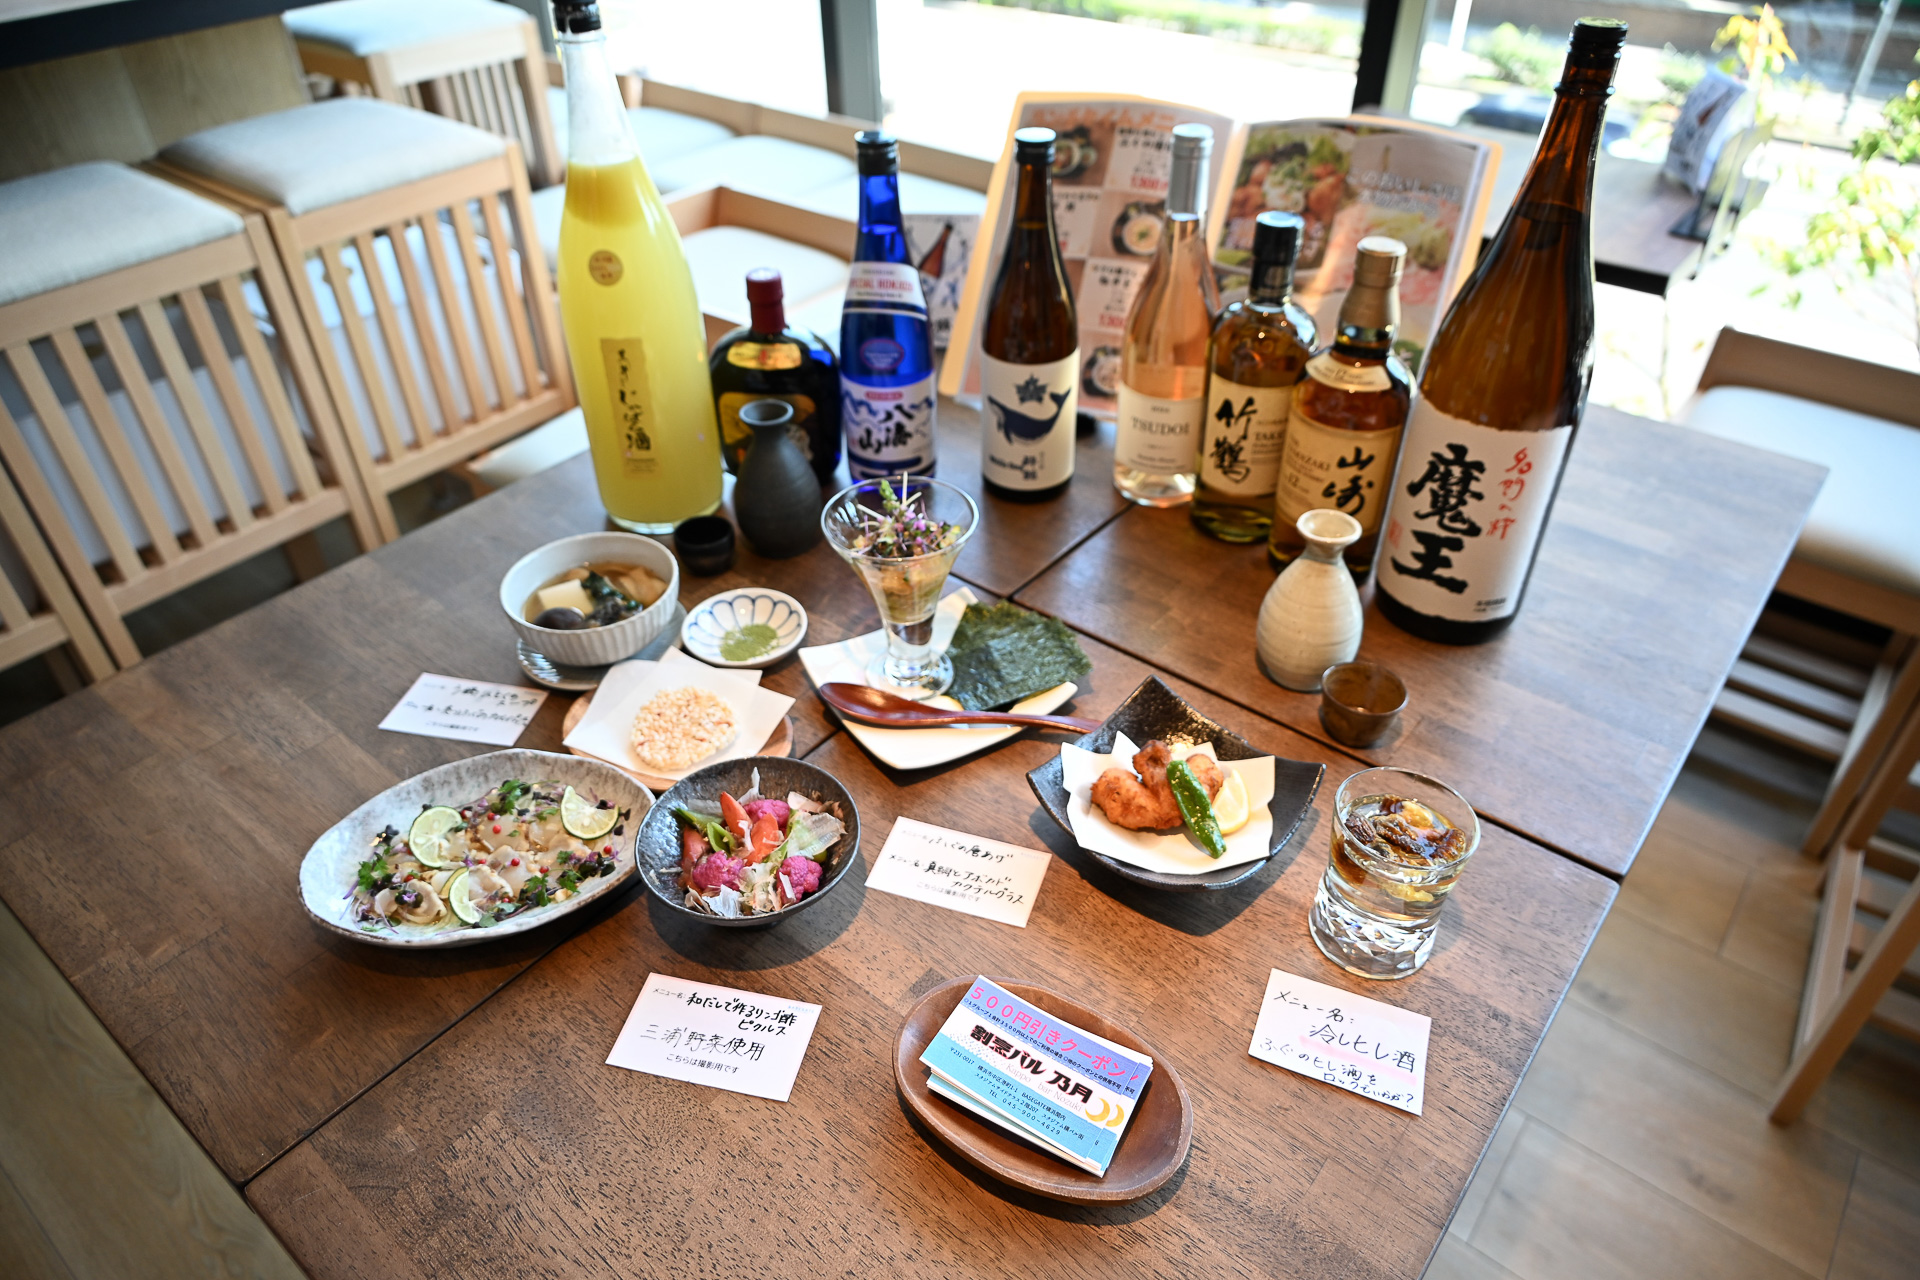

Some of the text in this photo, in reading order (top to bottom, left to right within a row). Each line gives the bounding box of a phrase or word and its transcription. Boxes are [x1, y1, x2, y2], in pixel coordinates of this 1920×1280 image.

[858, 403, 916, 454] 八海山
[1210, 397, 1257, 483] 竹鶴
[1391, 443, 1487, 594] 魔王
[640, 1023, 766, 1062] 三浦野菜使用
[737, 1019, 787, 1036] ピクルス
[665, 1053, 740, 1075] こちらは撮影用です
[970, 1024, 1094, 1104] 割烹バル 乃月
[1006, 1062, 1083, 1113] Kappo bar Nozuki
[989, 1089, 998, 1099] TEL
